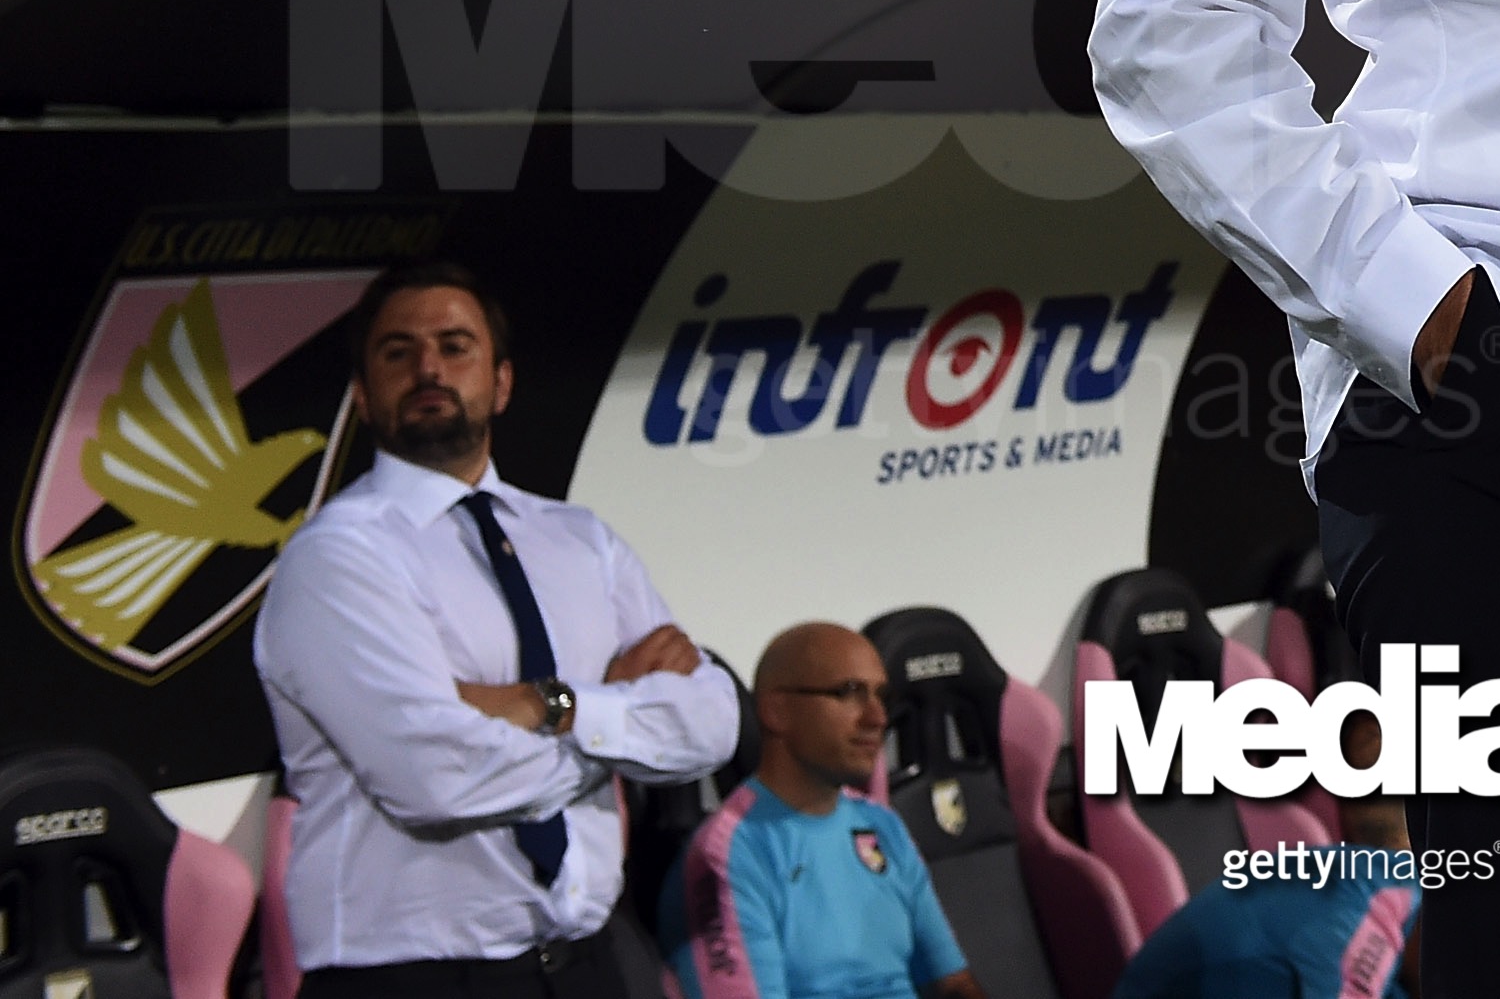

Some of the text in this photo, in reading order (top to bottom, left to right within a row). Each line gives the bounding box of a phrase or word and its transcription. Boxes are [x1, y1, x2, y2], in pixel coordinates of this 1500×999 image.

[643, 260, 1180, 448] infront
[876, 427, 1122, 485] SPORTS & MEDIA
